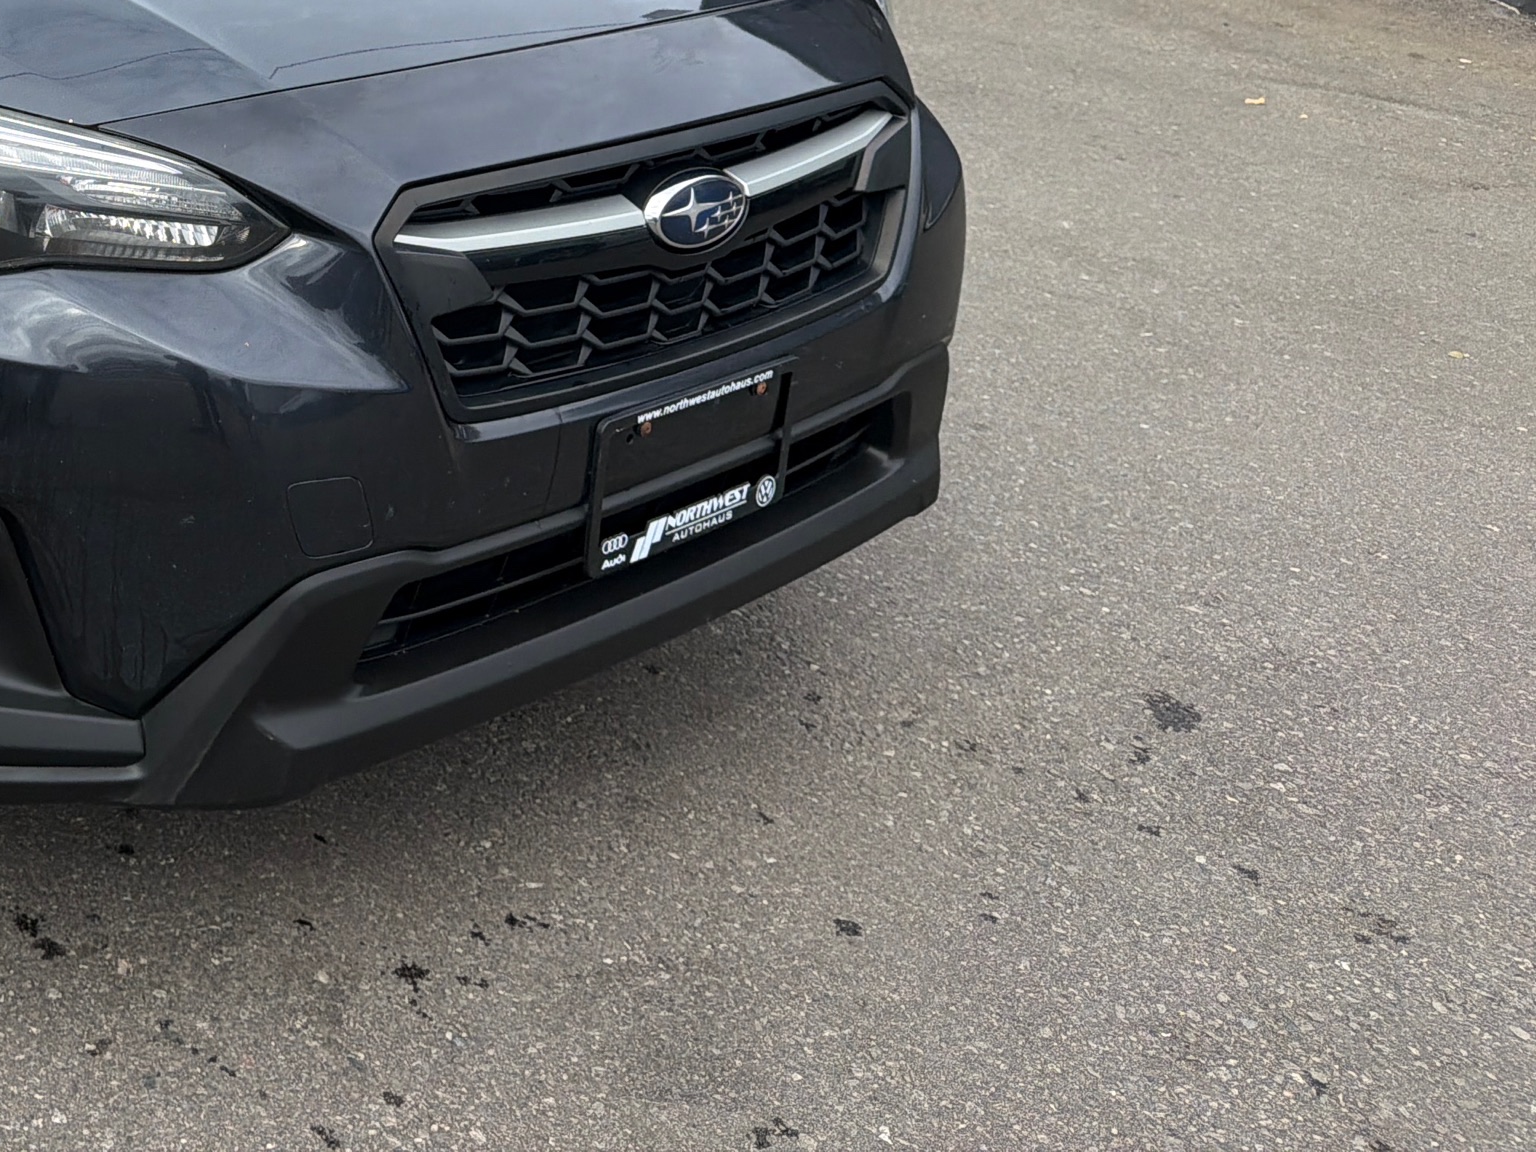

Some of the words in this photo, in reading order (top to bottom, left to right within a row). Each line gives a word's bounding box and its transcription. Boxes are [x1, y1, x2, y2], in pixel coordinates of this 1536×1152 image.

[637, 369, 774, 424] www.northwestautohaus.com
[665, 482, 751, 530] NORTHWEST
[671, 509, 733, 543] AUTOHAUS
